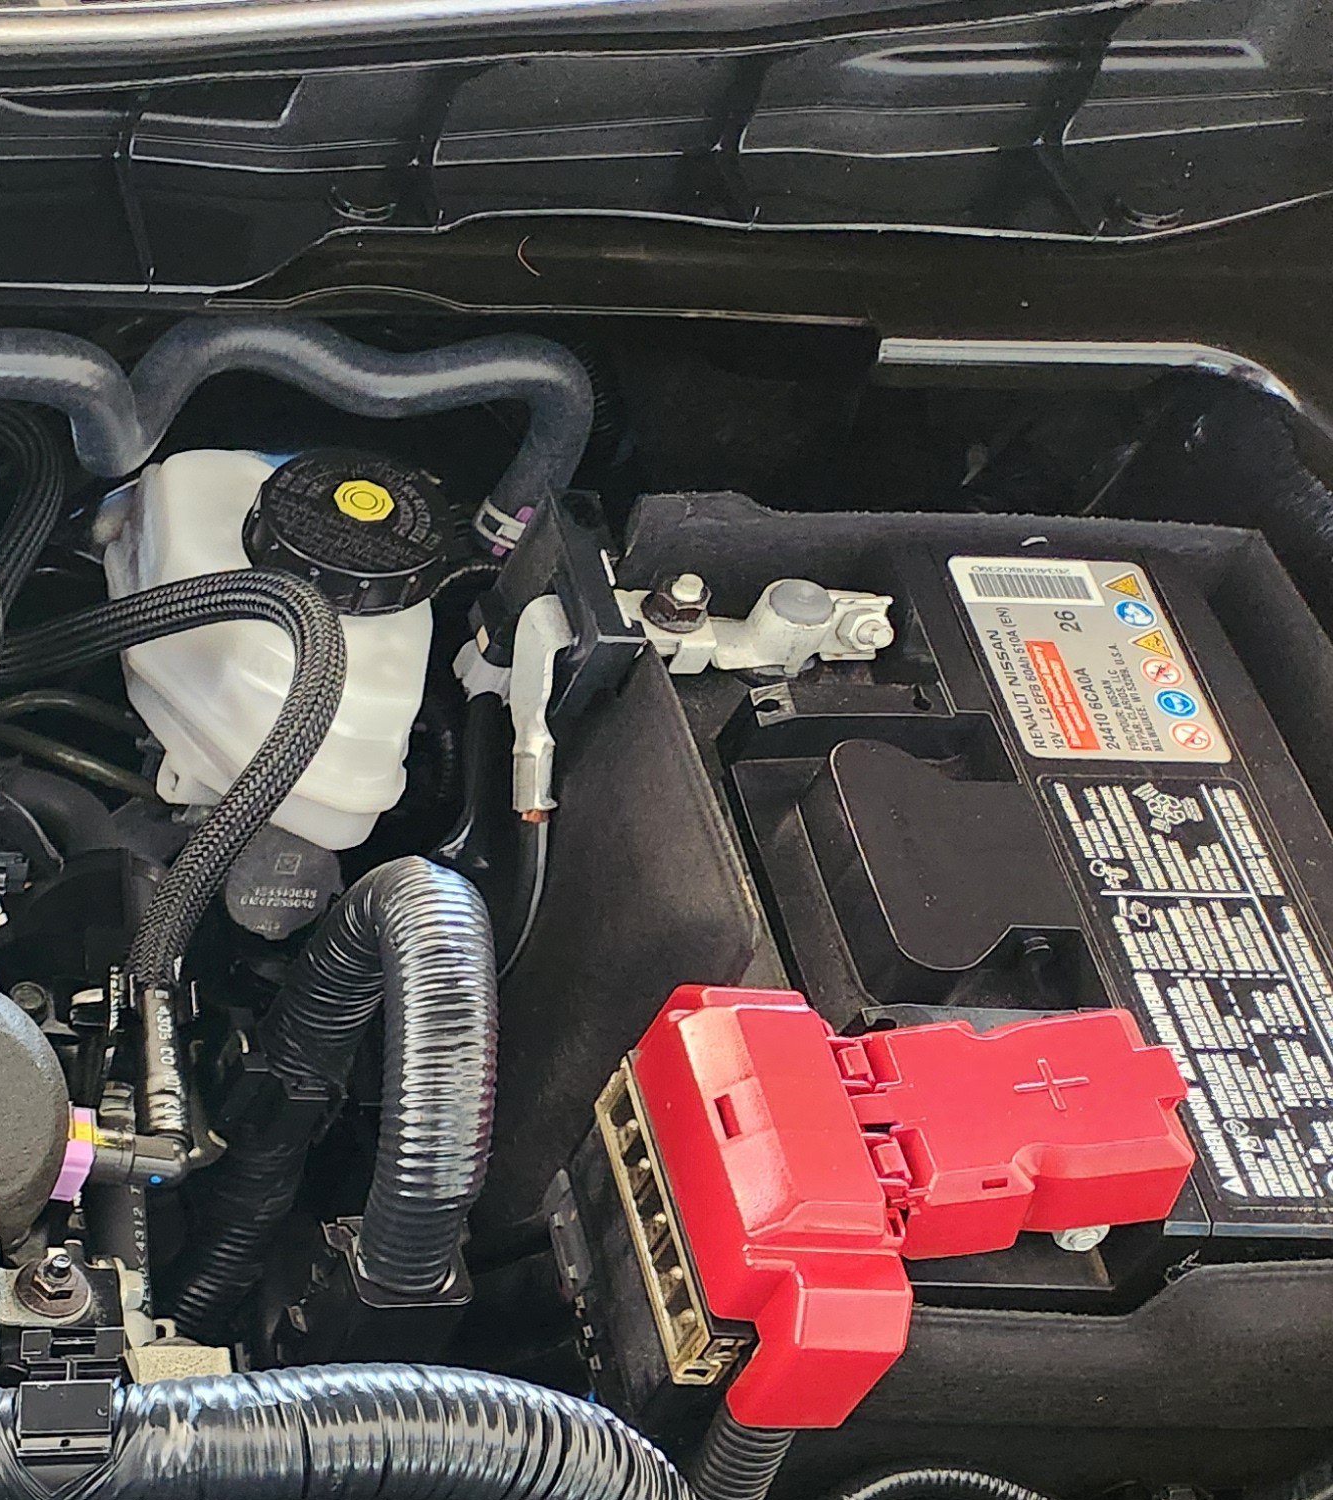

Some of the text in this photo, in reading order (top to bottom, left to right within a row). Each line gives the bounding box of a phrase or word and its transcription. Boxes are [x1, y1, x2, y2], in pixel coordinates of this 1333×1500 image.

[996, 607, 1016, 627] (EN)
[1060, 610, 1084, 633] 26
[1007, 630, 1025, 653] 510A
[987, 630, 1047, 748] RENAULT NISSAN
[1029, 684, 1047, 704] EFB
[1039, 708, 1054, 720] L2
[1074, 668, 1120, 750] 24410 6CA0A
[1049, 731, 1066, 749] 12V
